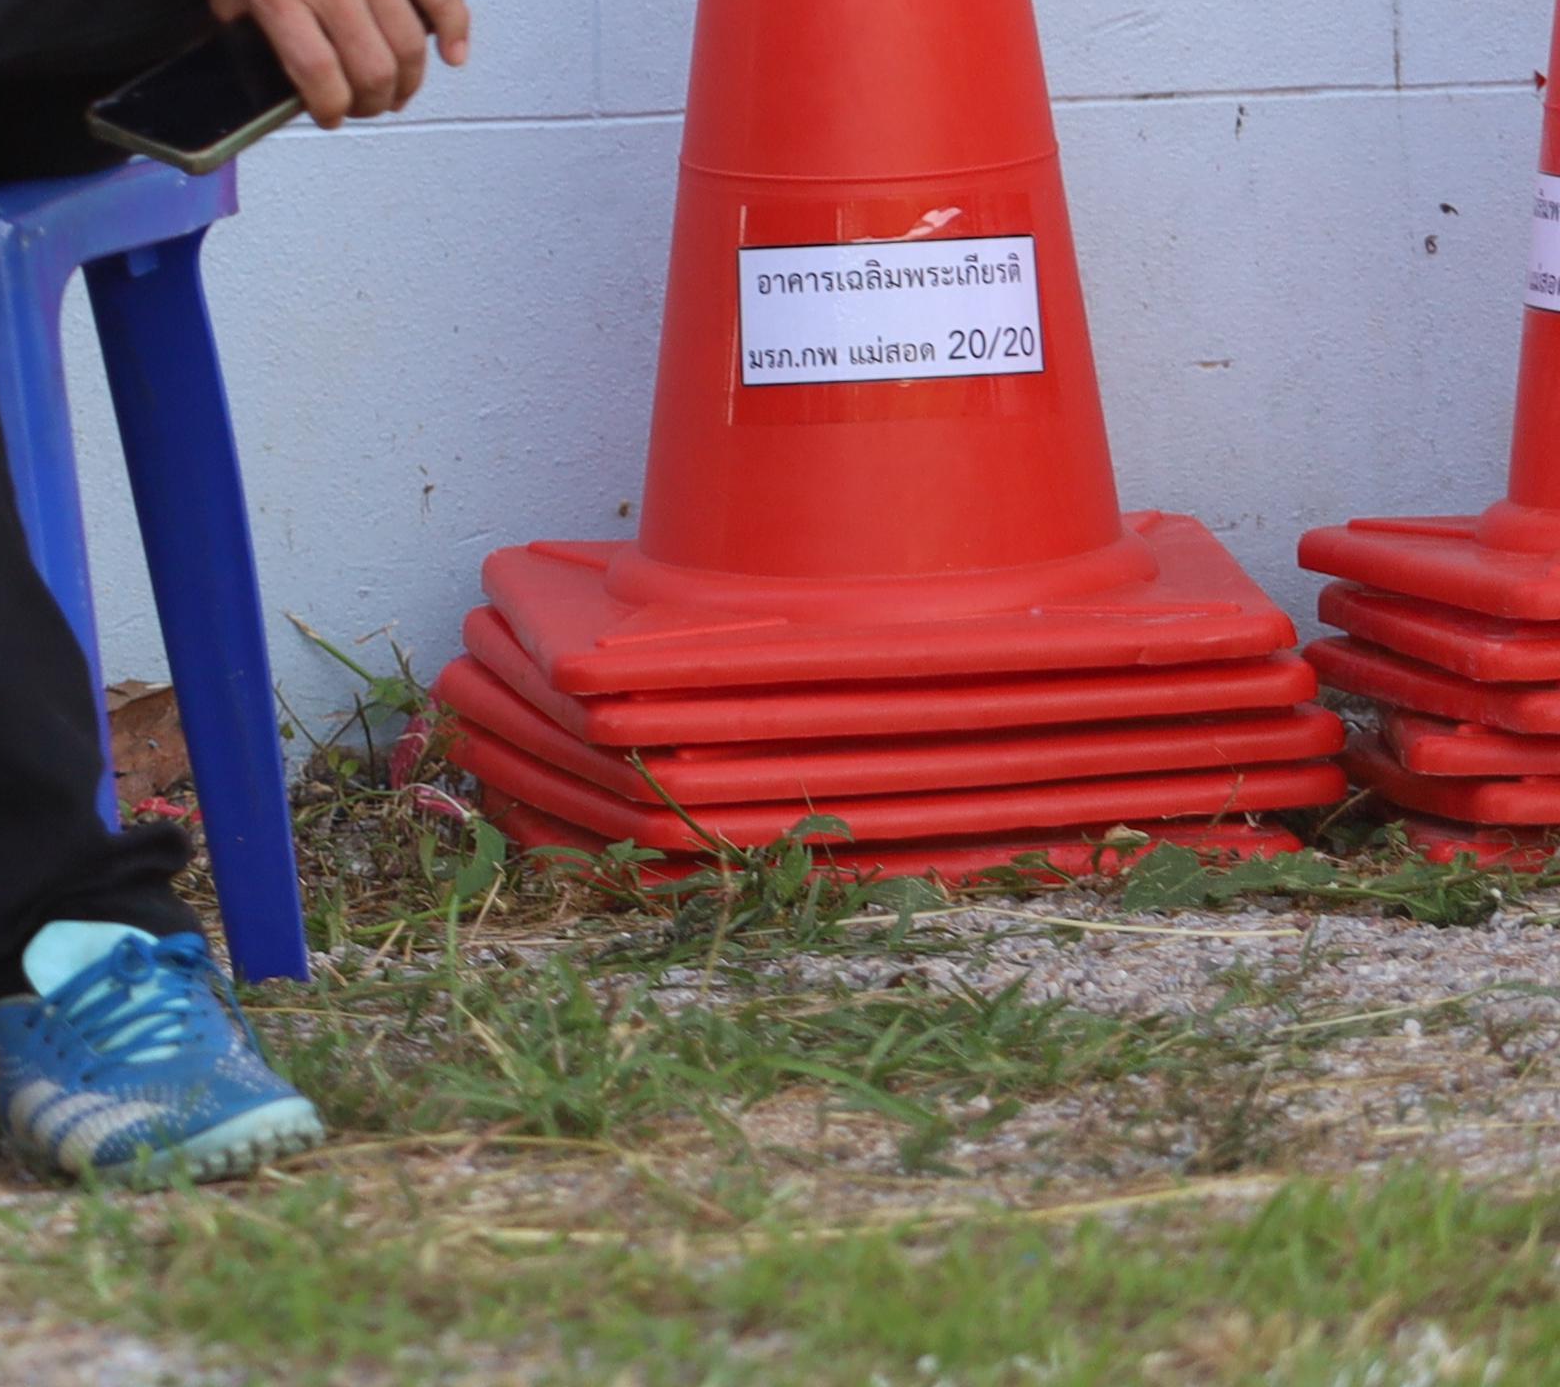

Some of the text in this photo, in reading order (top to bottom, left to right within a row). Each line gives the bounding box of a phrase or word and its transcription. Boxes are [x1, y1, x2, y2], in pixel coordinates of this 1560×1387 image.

[758, 253, 1022, 294] อาคารเฉลิมพระเกียรติ
[849, 335, 936, 366] แม่สอด
[948, 326, 1035, 360] 20/20
